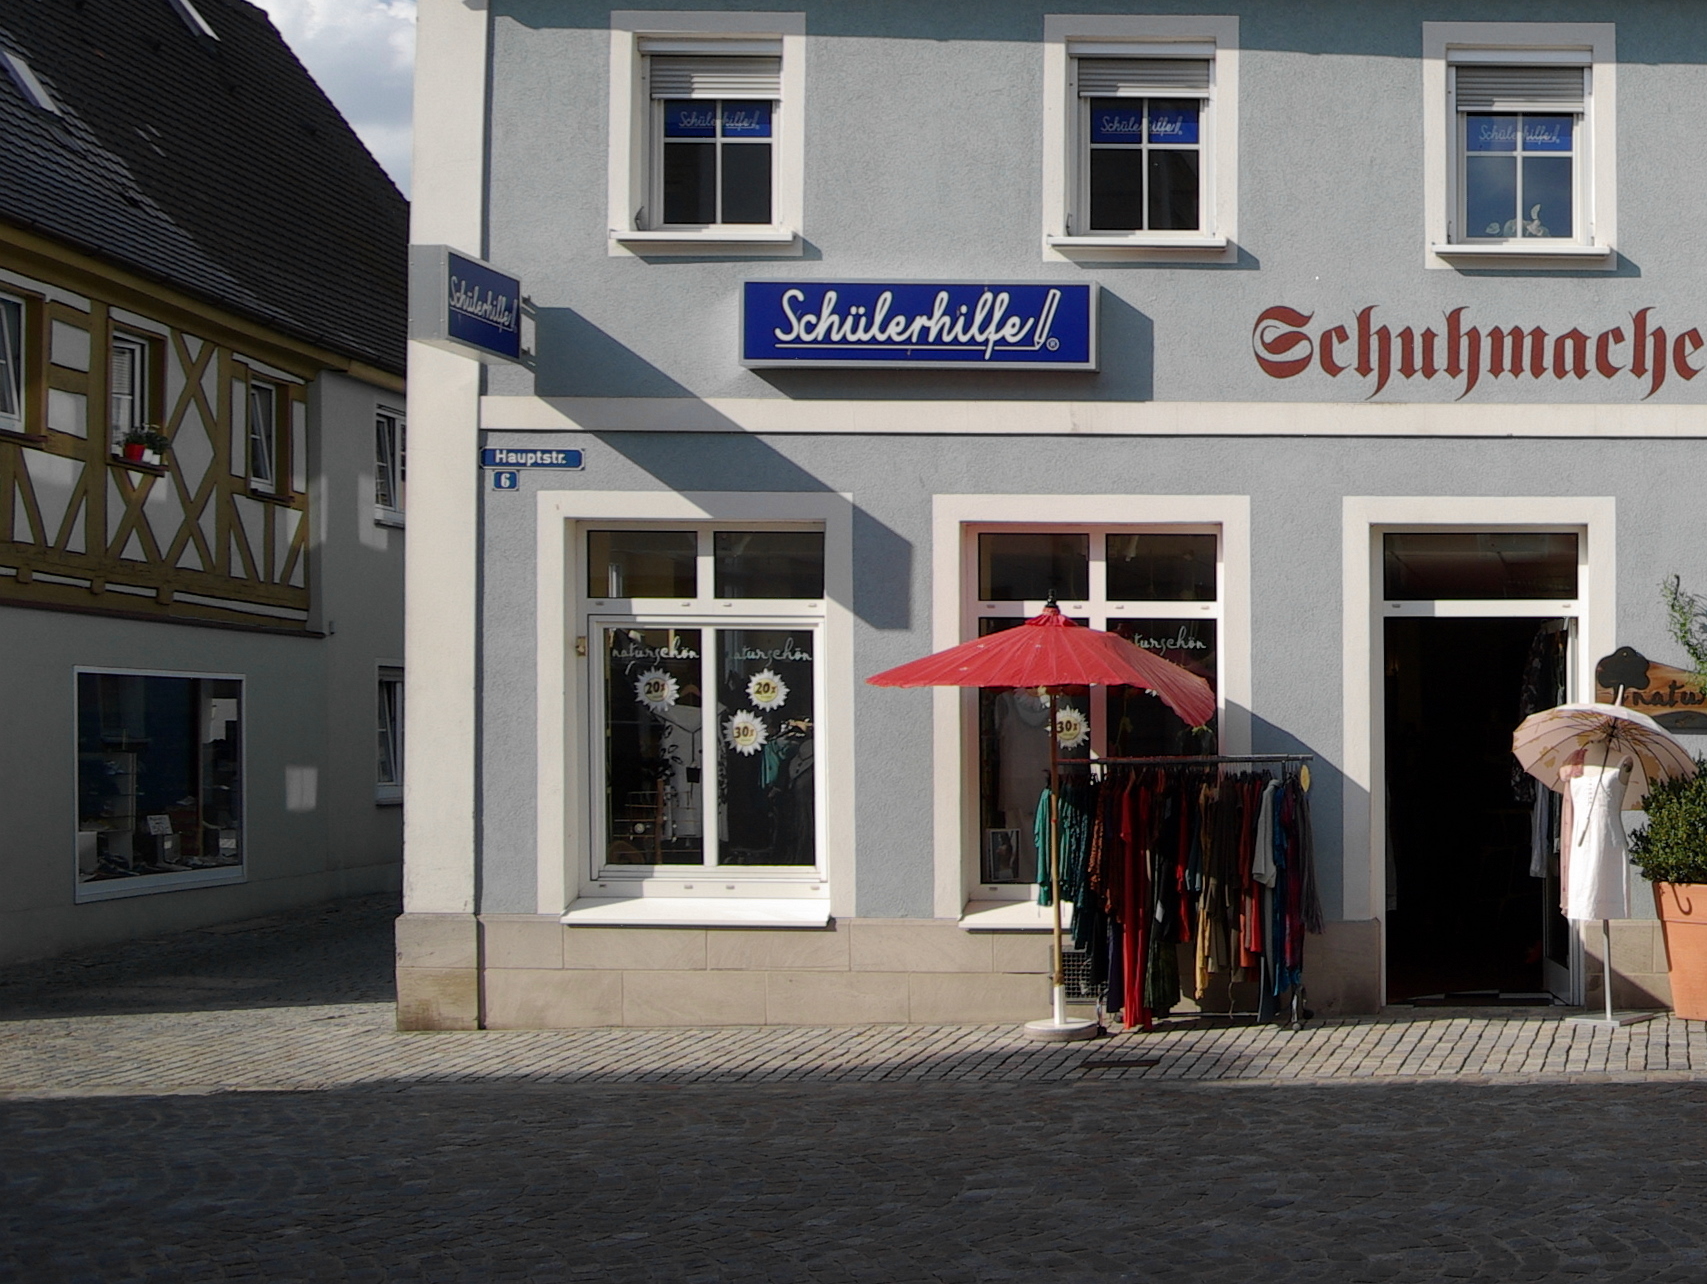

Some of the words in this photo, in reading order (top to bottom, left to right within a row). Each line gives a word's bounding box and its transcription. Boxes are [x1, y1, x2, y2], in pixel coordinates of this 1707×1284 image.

[495, 449, 567, 467] Hauptstr.
[500, 473, 511, 487] 6
[612, 635, 700, 665] naturschön
[728, 637, 812, 667] aturschön
[1134, 625, 1207, 656] turschön
